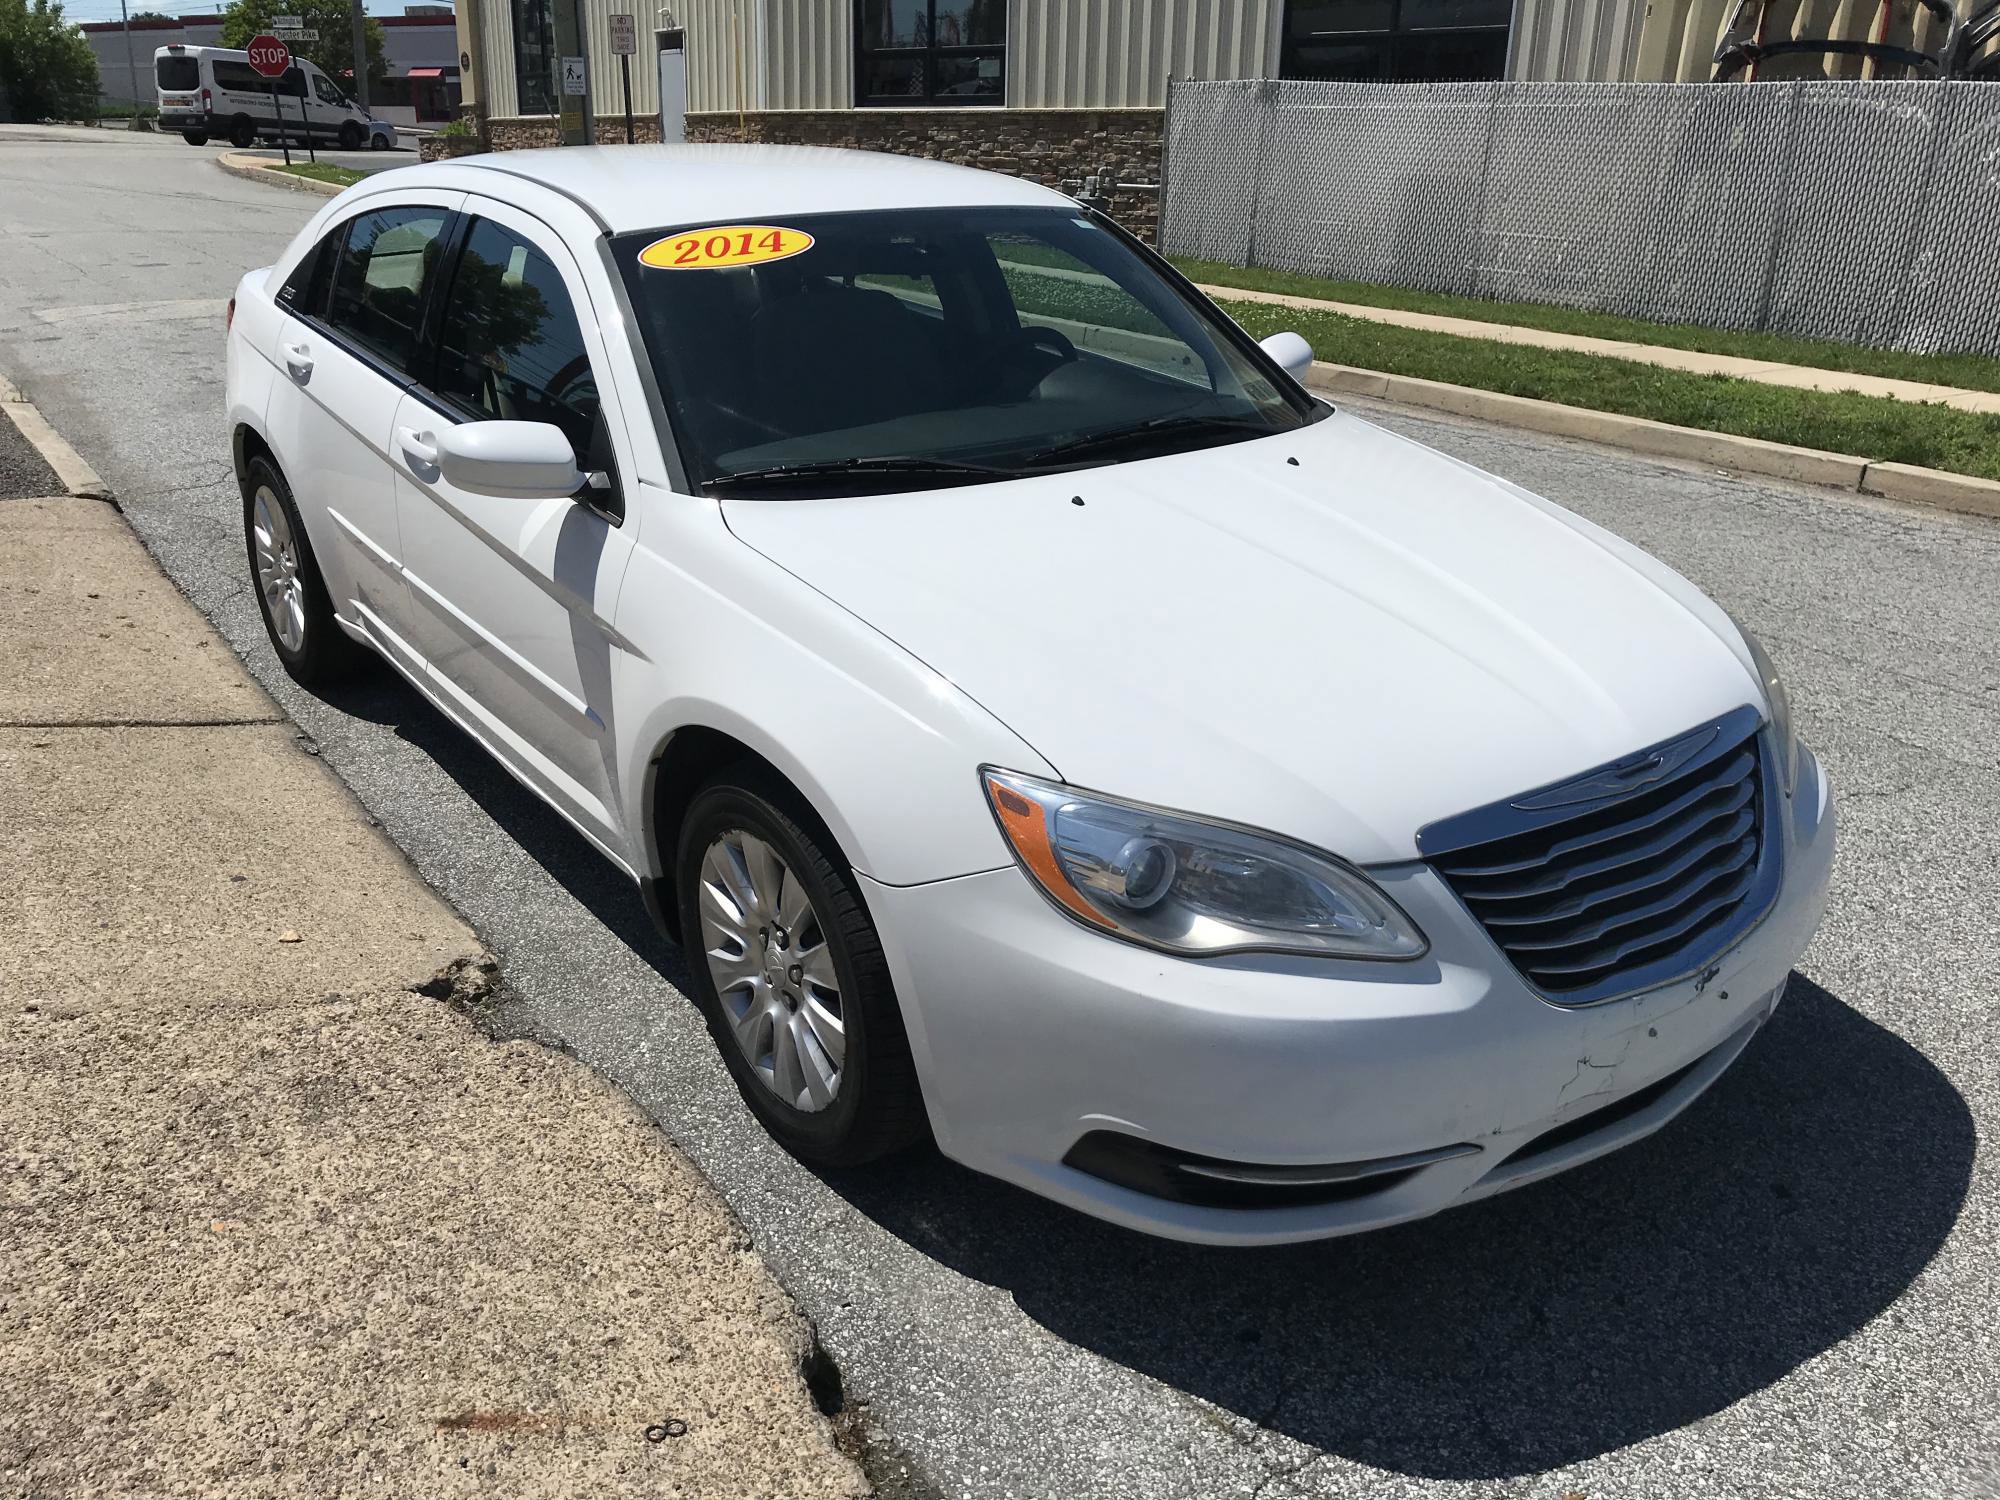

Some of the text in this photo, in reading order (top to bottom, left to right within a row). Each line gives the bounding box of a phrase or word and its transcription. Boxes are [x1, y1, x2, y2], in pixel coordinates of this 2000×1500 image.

[617, 17, 627, 25] NO
[273, 29, 300, 40] Chester
[301, 29, 317, 40] Pike
[611, 26, 633, 34] PARKING
[250, 48, 286, 64] STOP
[674, 231, 787, 264] 2014
